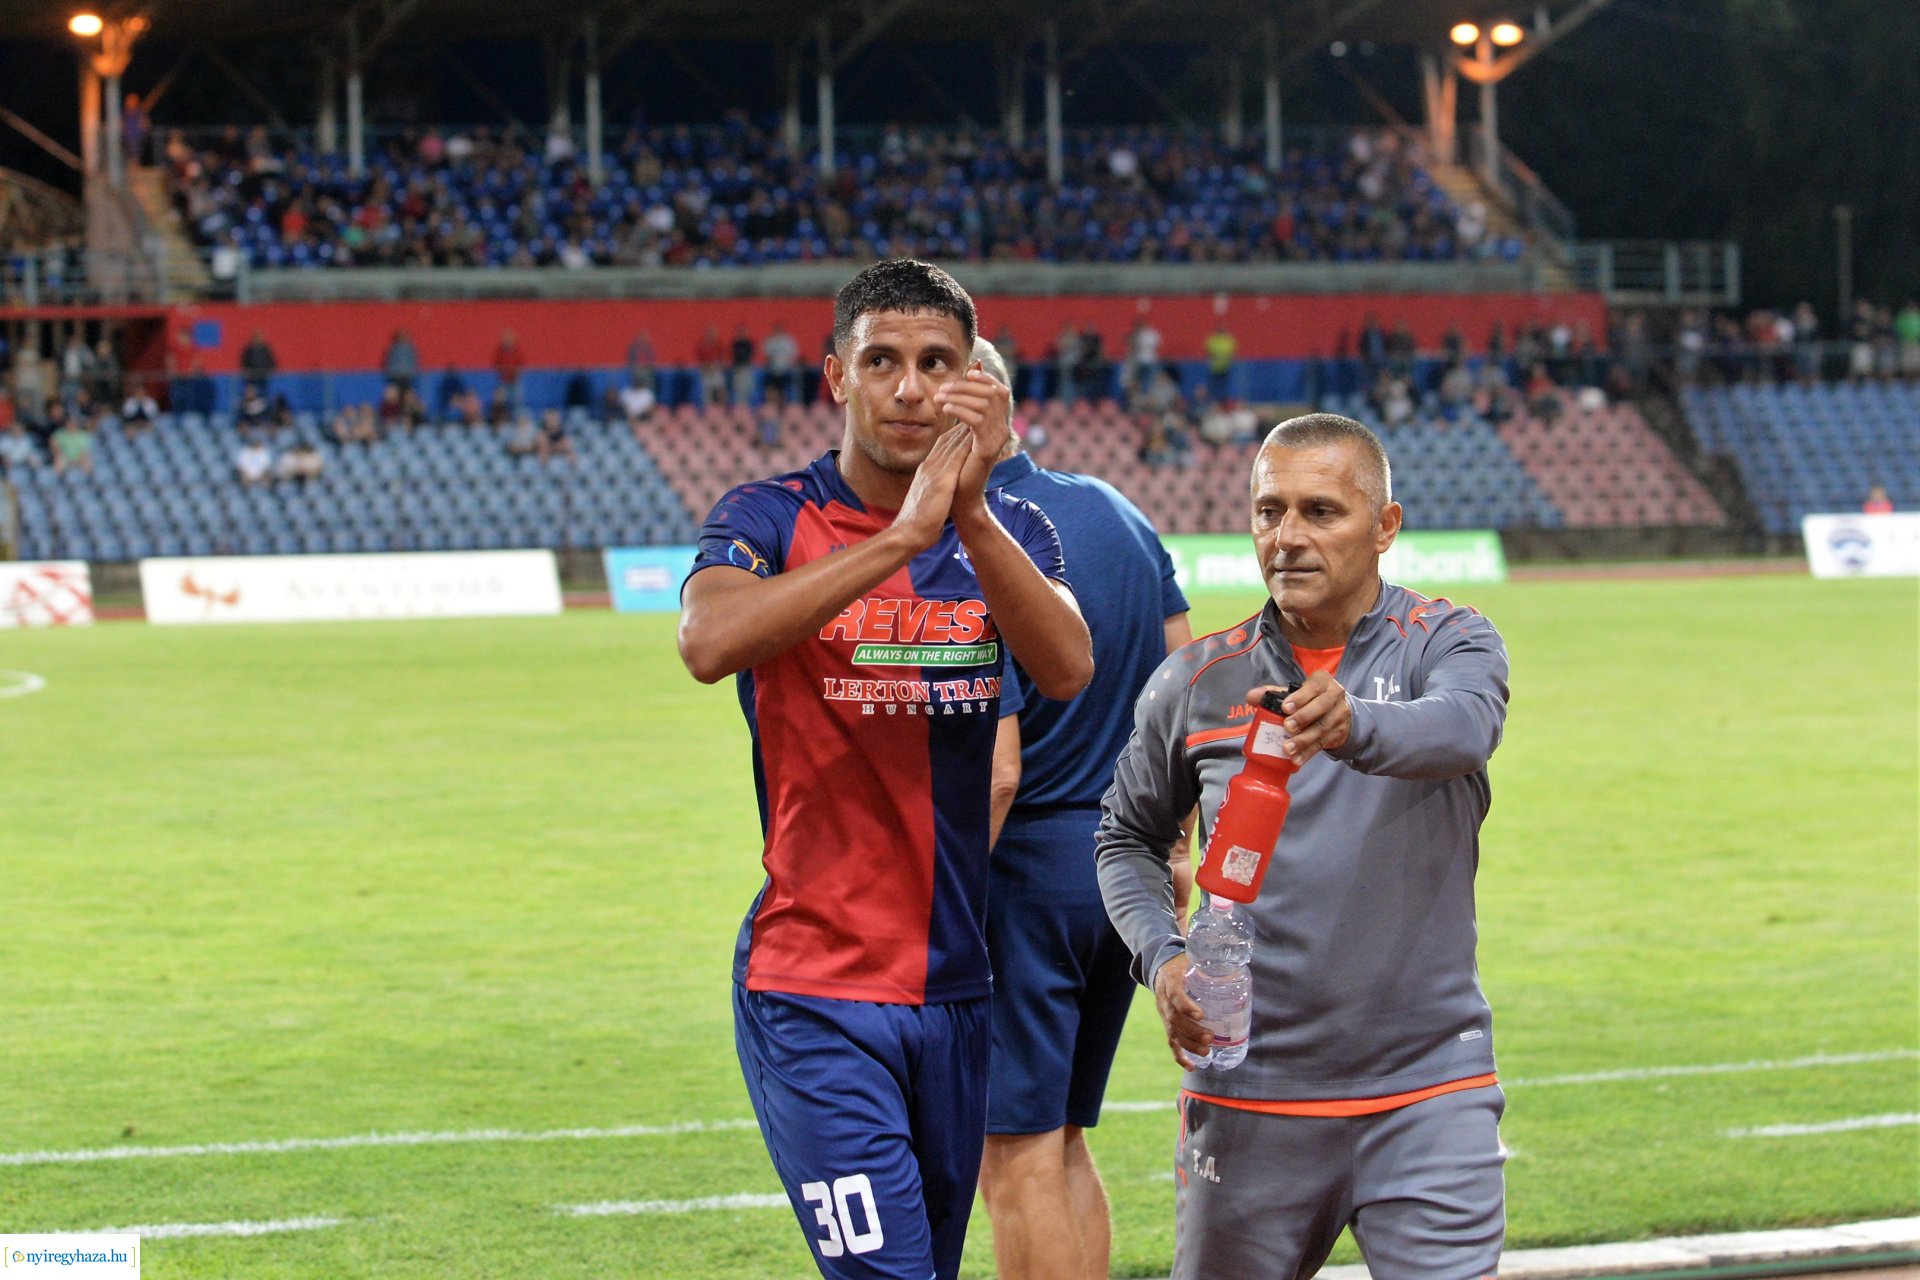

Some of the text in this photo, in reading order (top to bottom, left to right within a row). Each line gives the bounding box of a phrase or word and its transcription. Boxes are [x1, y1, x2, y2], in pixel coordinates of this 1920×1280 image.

[857, 647, 993, 661] ALWAYS ON THE RIGHT WAY
[823, 677, 931, 703] LERTON
[861, 701, 989, 716] HUNGARY
[1226, 703, 1258, 719] JAK
[801, 1173, 884, 1257] 30
